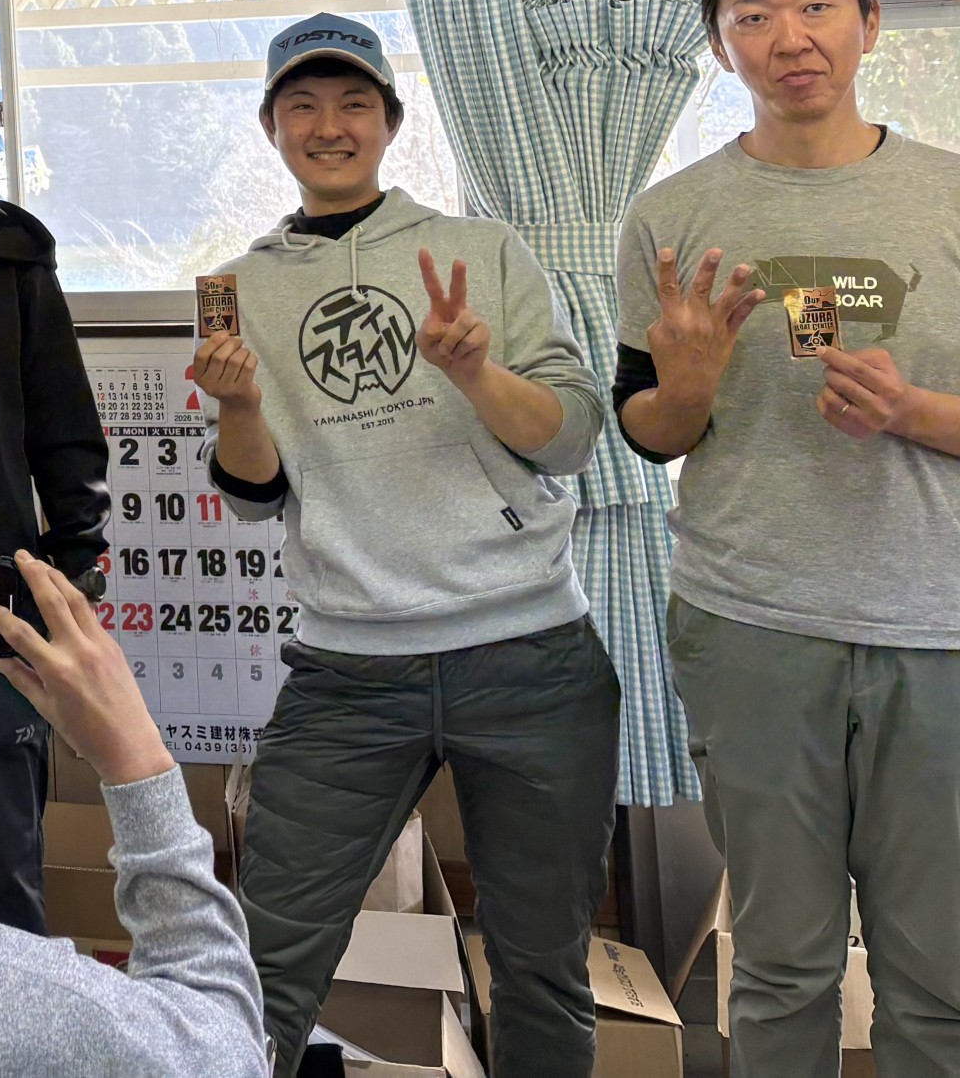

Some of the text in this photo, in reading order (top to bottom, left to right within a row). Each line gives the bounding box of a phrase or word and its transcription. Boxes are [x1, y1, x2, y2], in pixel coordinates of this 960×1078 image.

[293, 29, 374, 50] DSTYLE
[832, 275, 878, 290] WILD
[812, 322, 833, 331] CENTER
[97, 393, 164, 401] 12 13 14 15 16 17
[97, 402, 165, 410] 19 20 21 22 23 24
[112, 427, 120, 436] 月
[123, 427, 145, 436] MON
[152, 427, 160, 436] 火
[163, 427, 181, 436] TUE
[119, 439, 177, 465] 2 3
[122, 493, 222, 521] 9 10 11
[120, 548, 266, 577] 16 17 18 19
[121, 603, 270, 633] 23 24 25 26
[134, 661, 262, 681] 2 3 4 5
